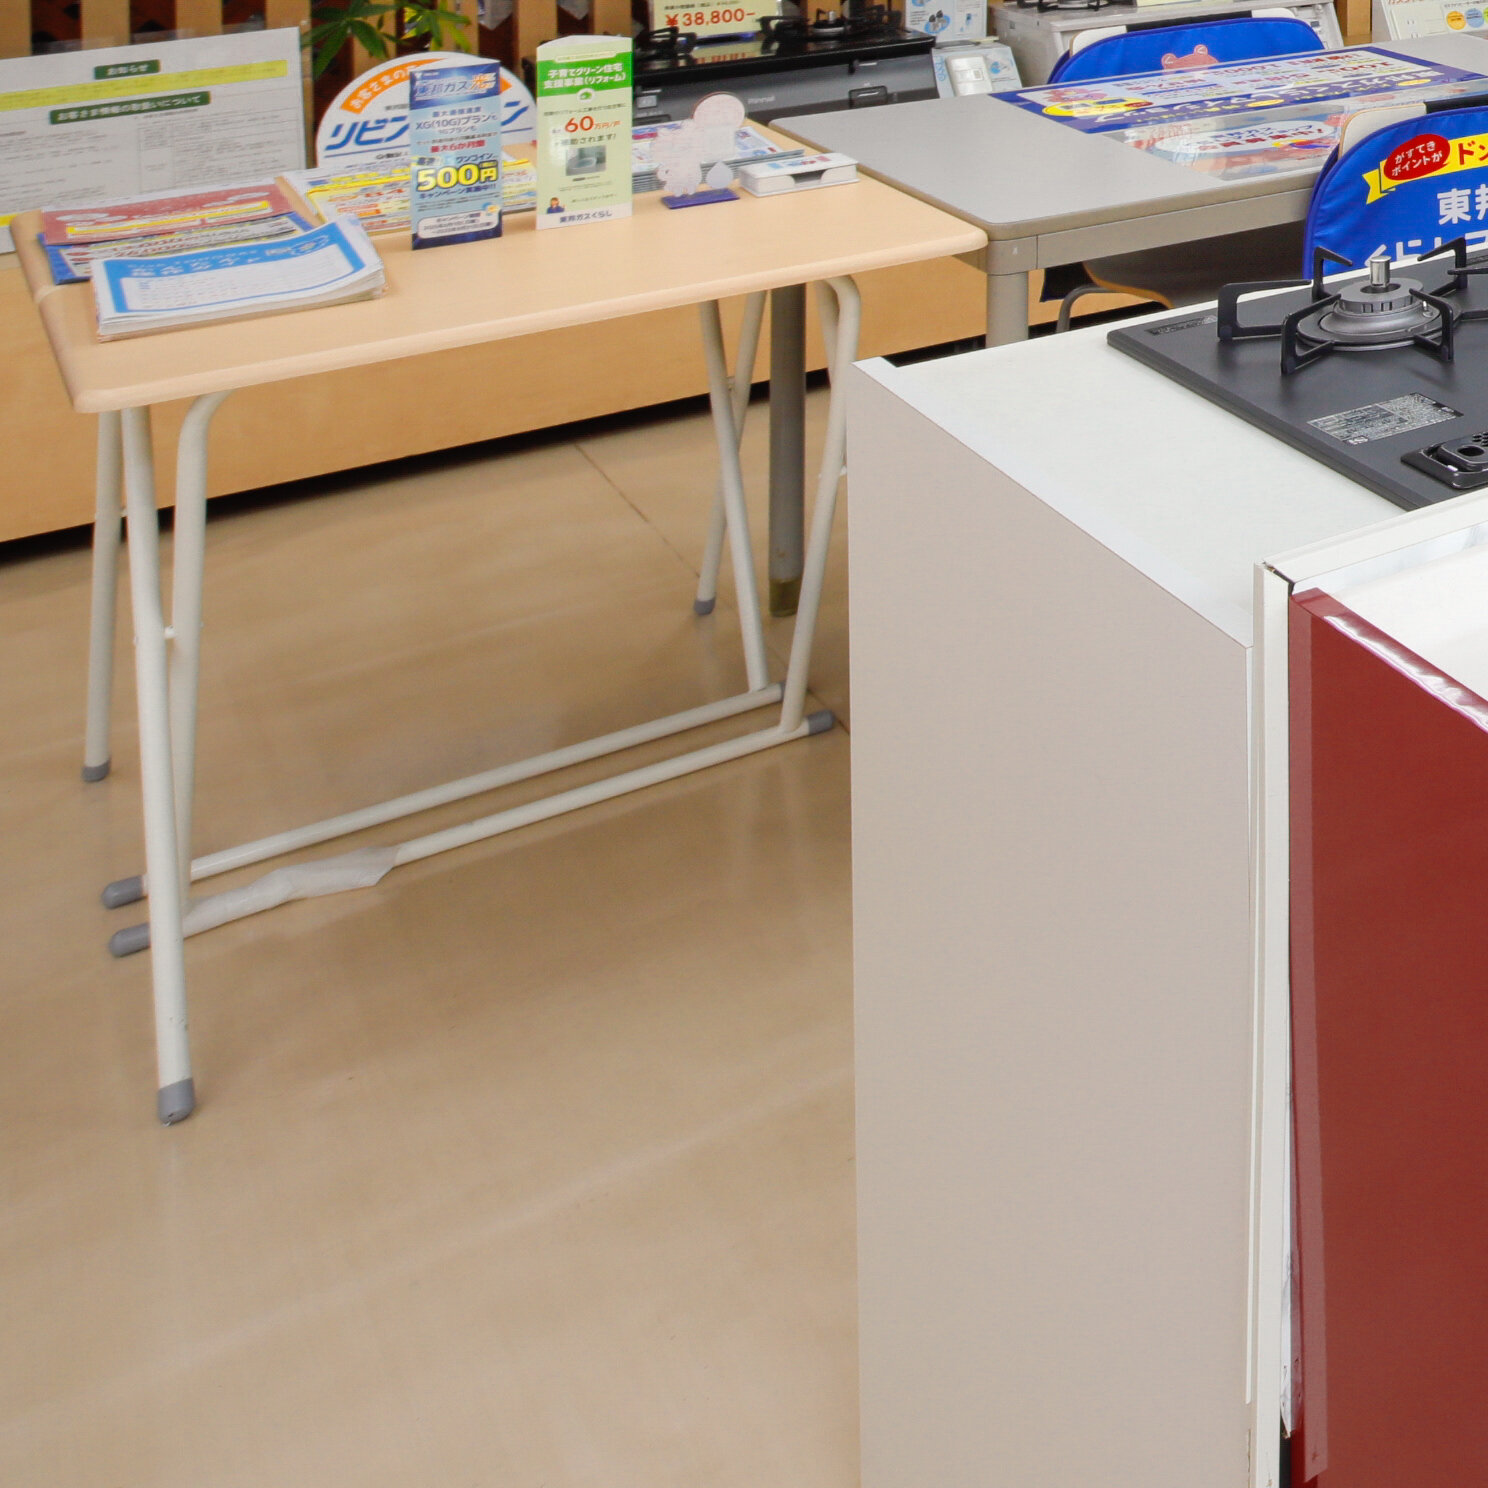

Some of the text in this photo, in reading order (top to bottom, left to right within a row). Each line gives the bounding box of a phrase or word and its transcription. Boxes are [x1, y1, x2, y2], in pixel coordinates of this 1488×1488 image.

[665, 9, 757, 28] ¥38,800-
[1391, 152, 1443, 176] ポイントが
[1394, 140, 1437, 164] がすてき
[417, 161, 497, 192] 500円
